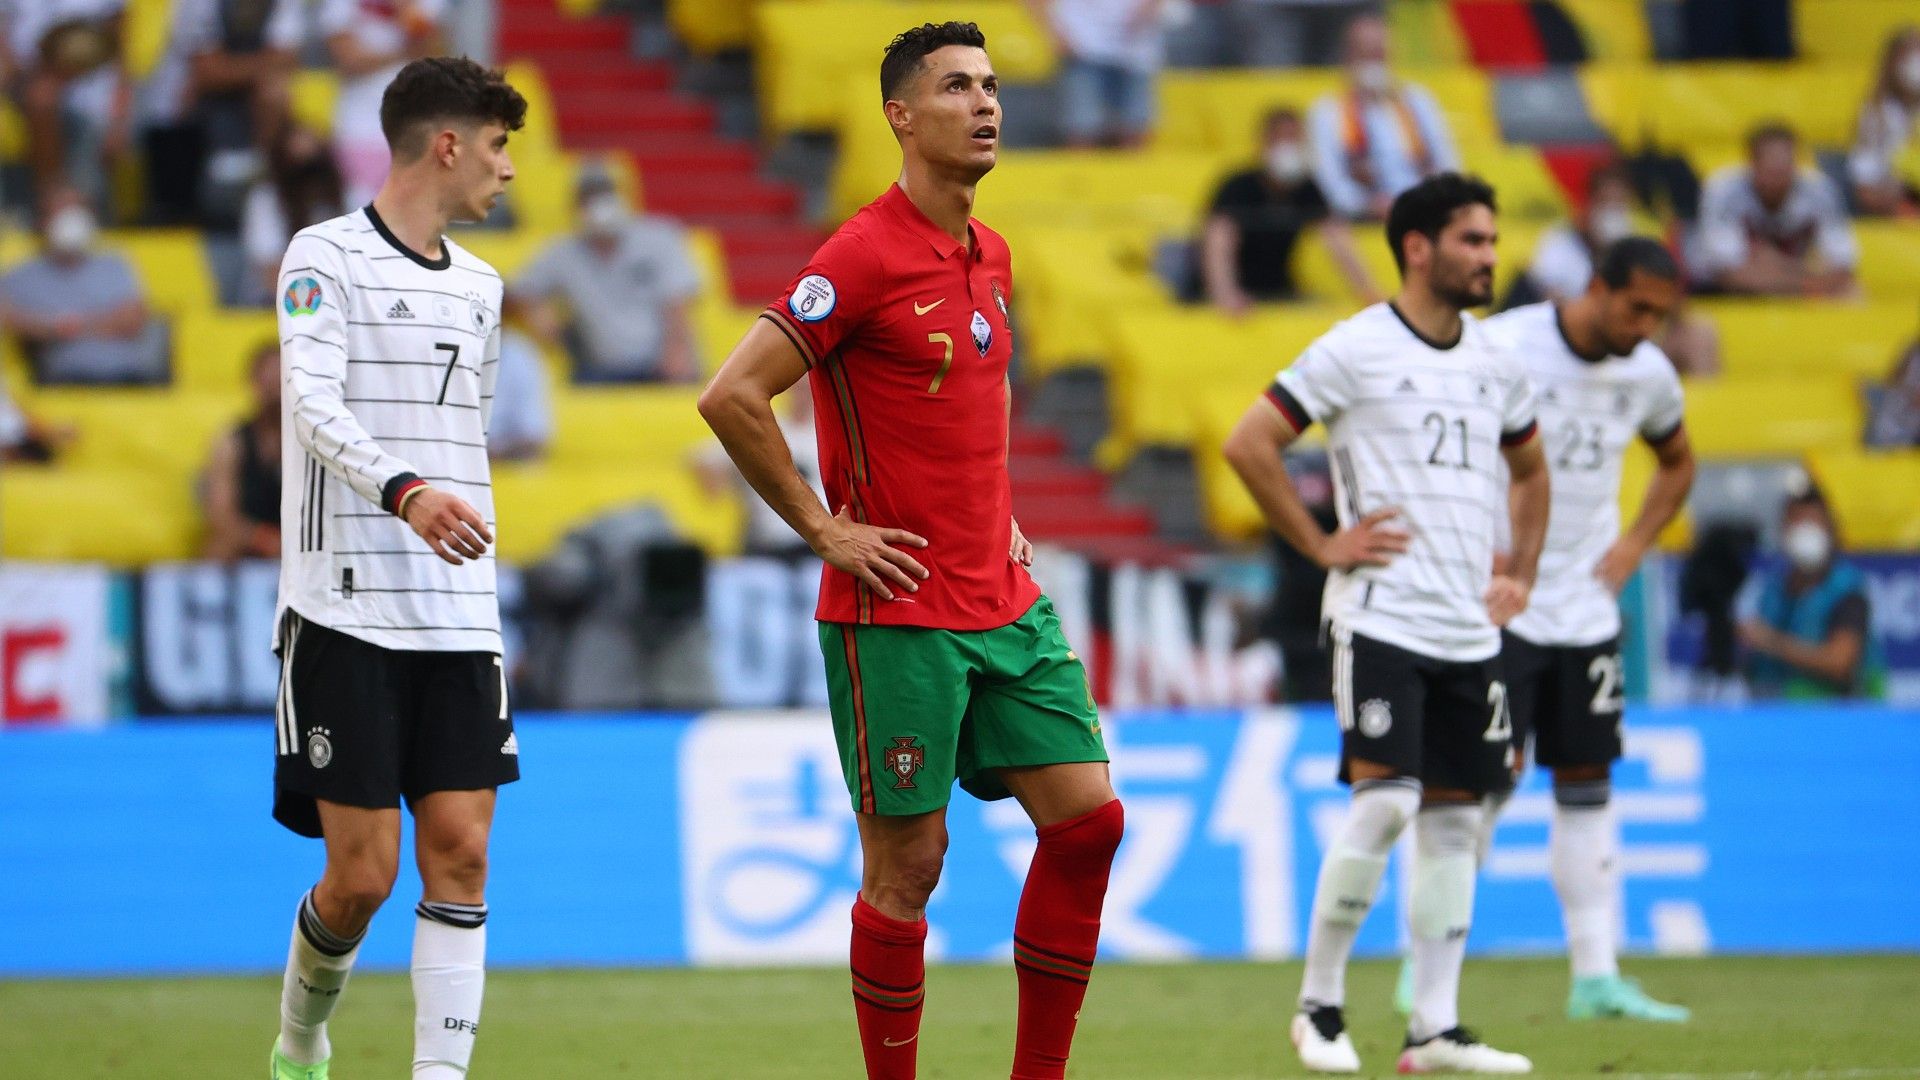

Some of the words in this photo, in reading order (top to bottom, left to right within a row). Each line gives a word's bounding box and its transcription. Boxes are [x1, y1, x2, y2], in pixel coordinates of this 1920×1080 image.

[386, 311, 416, 319] adidas
[434, 342, 460, 406] 7
[928, 332, 954, 394] 7
[1423, 412, 1472, 469] 21
[1556, 418, 1604, 471] 23
[493, 656, 508, 720] 7
